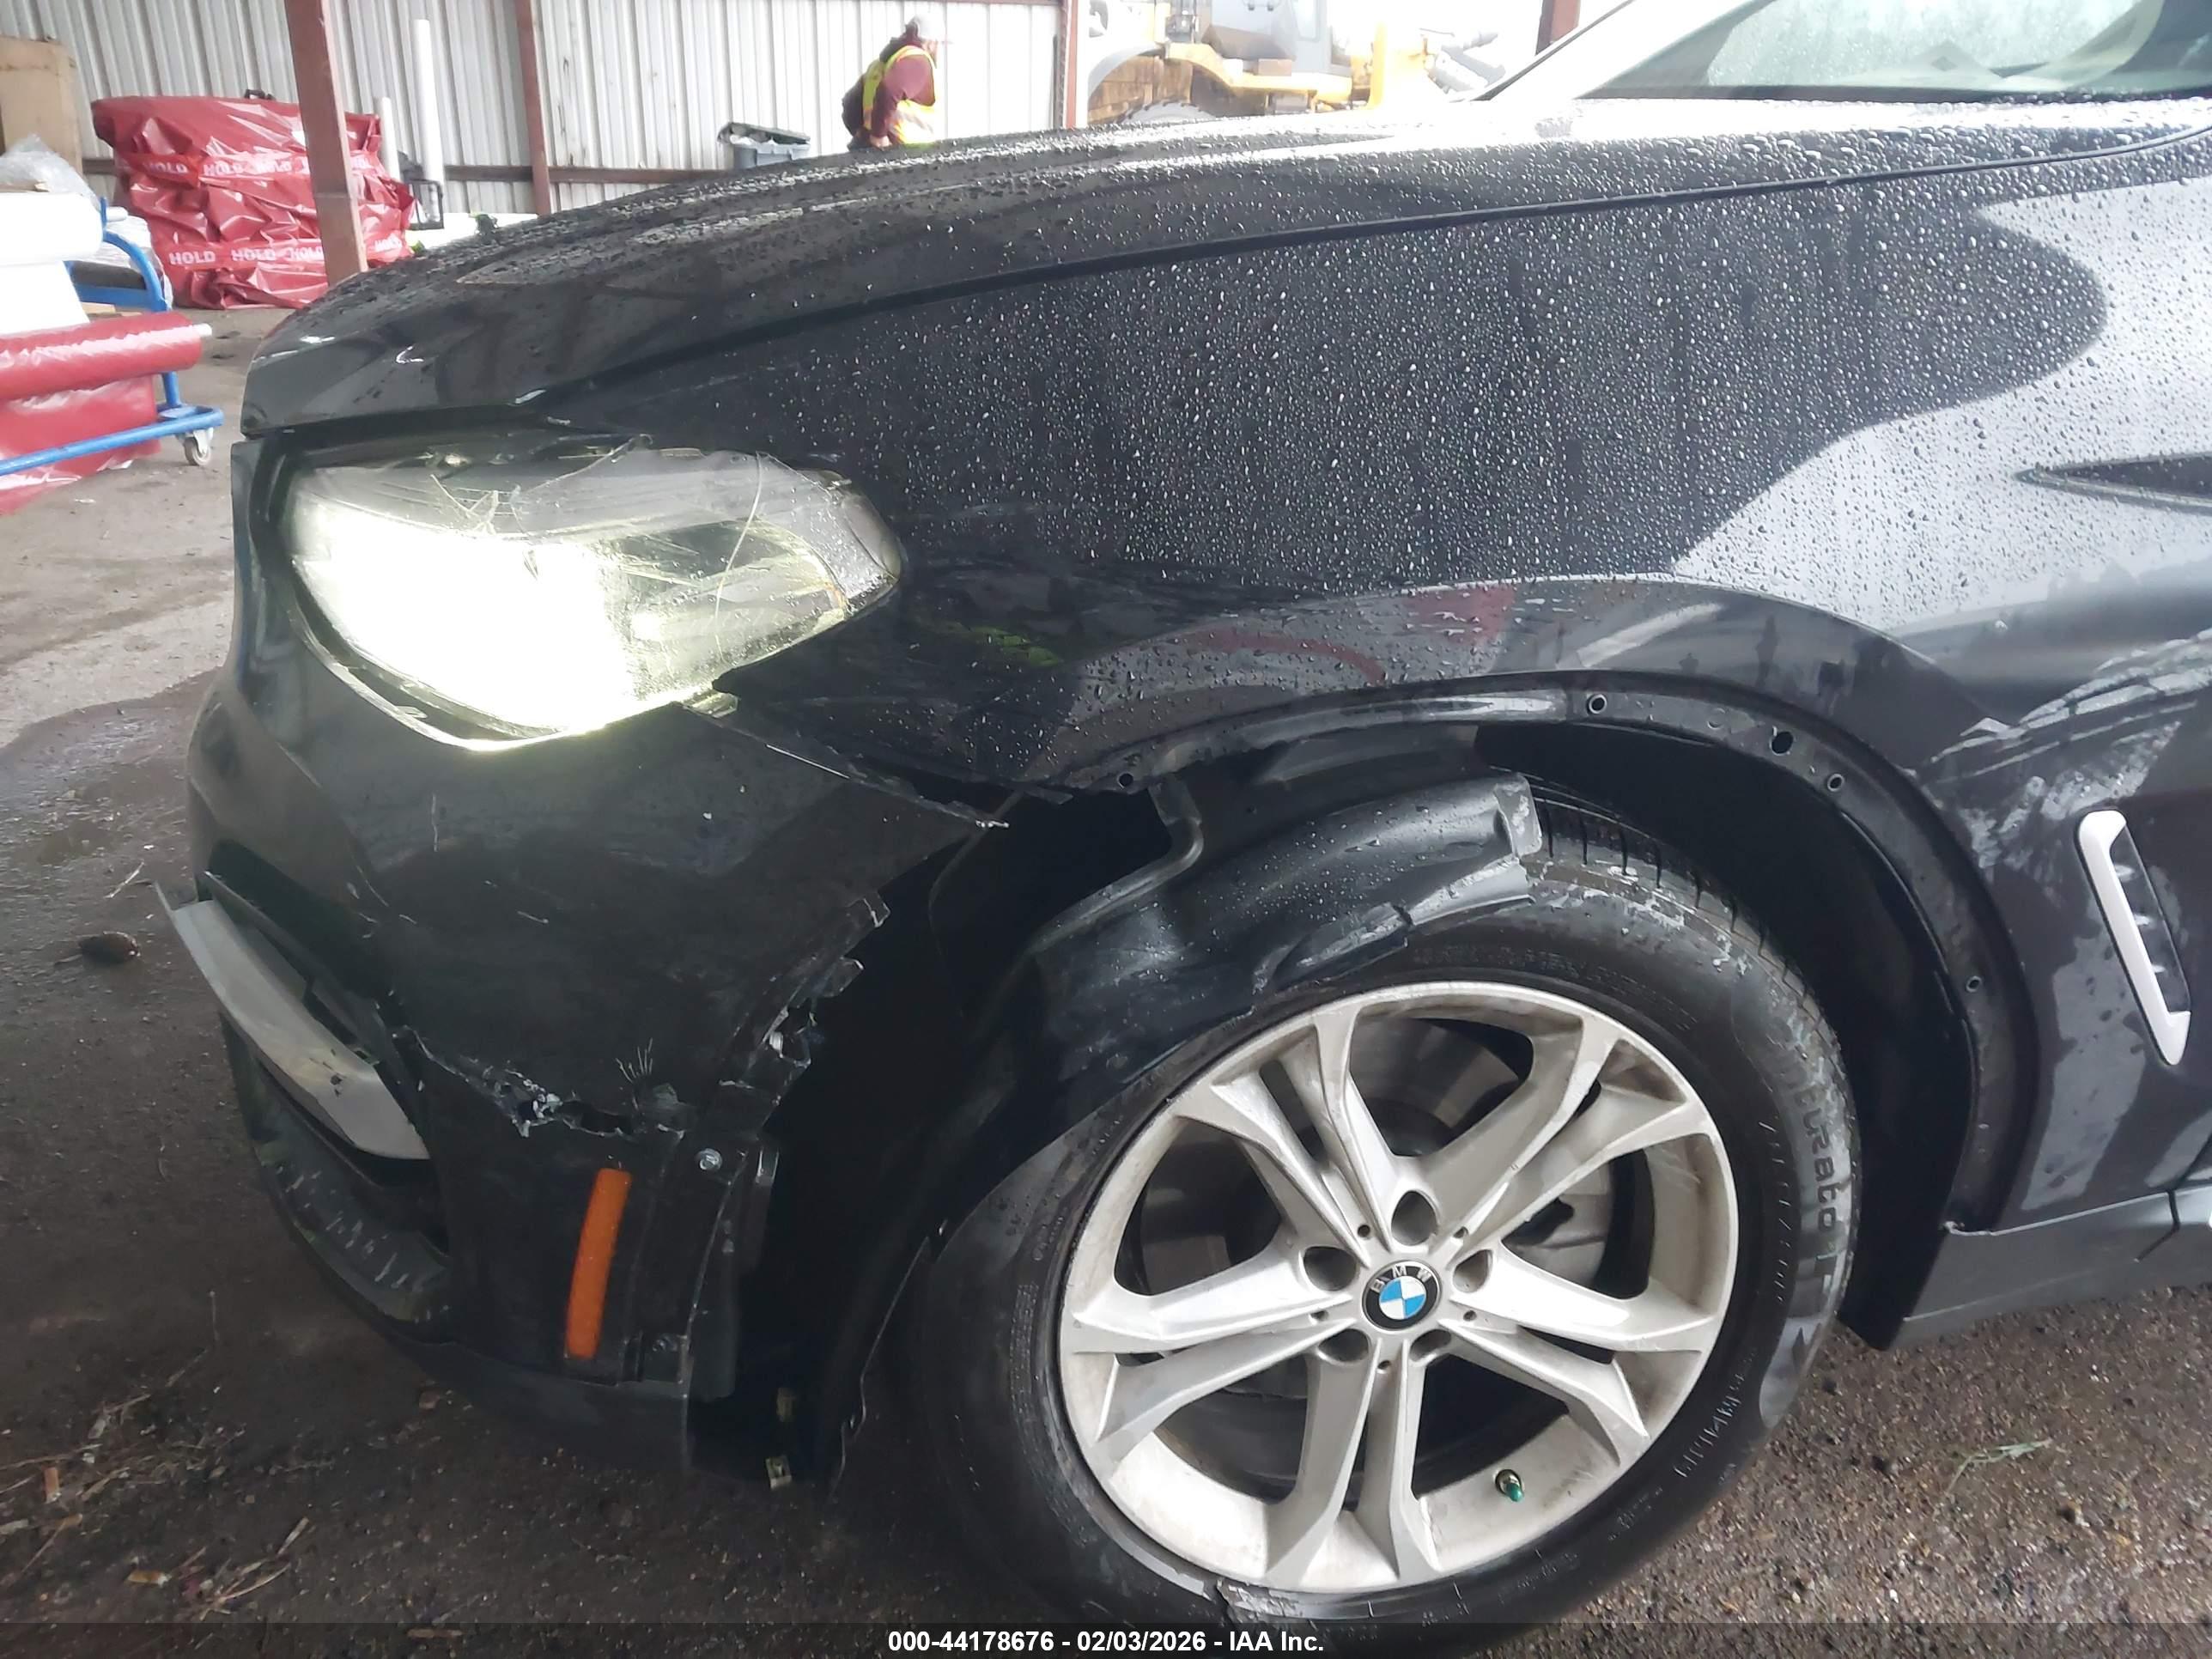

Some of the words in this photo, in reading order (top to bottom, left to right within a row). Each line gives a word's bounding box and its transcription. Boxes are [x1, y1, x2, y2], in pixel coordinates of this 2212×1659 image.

[168, 251, 216, 264] HOLD
[230, 247, 276, 261] HOLD
[1369, 1263, 1432, 1294] BMW
